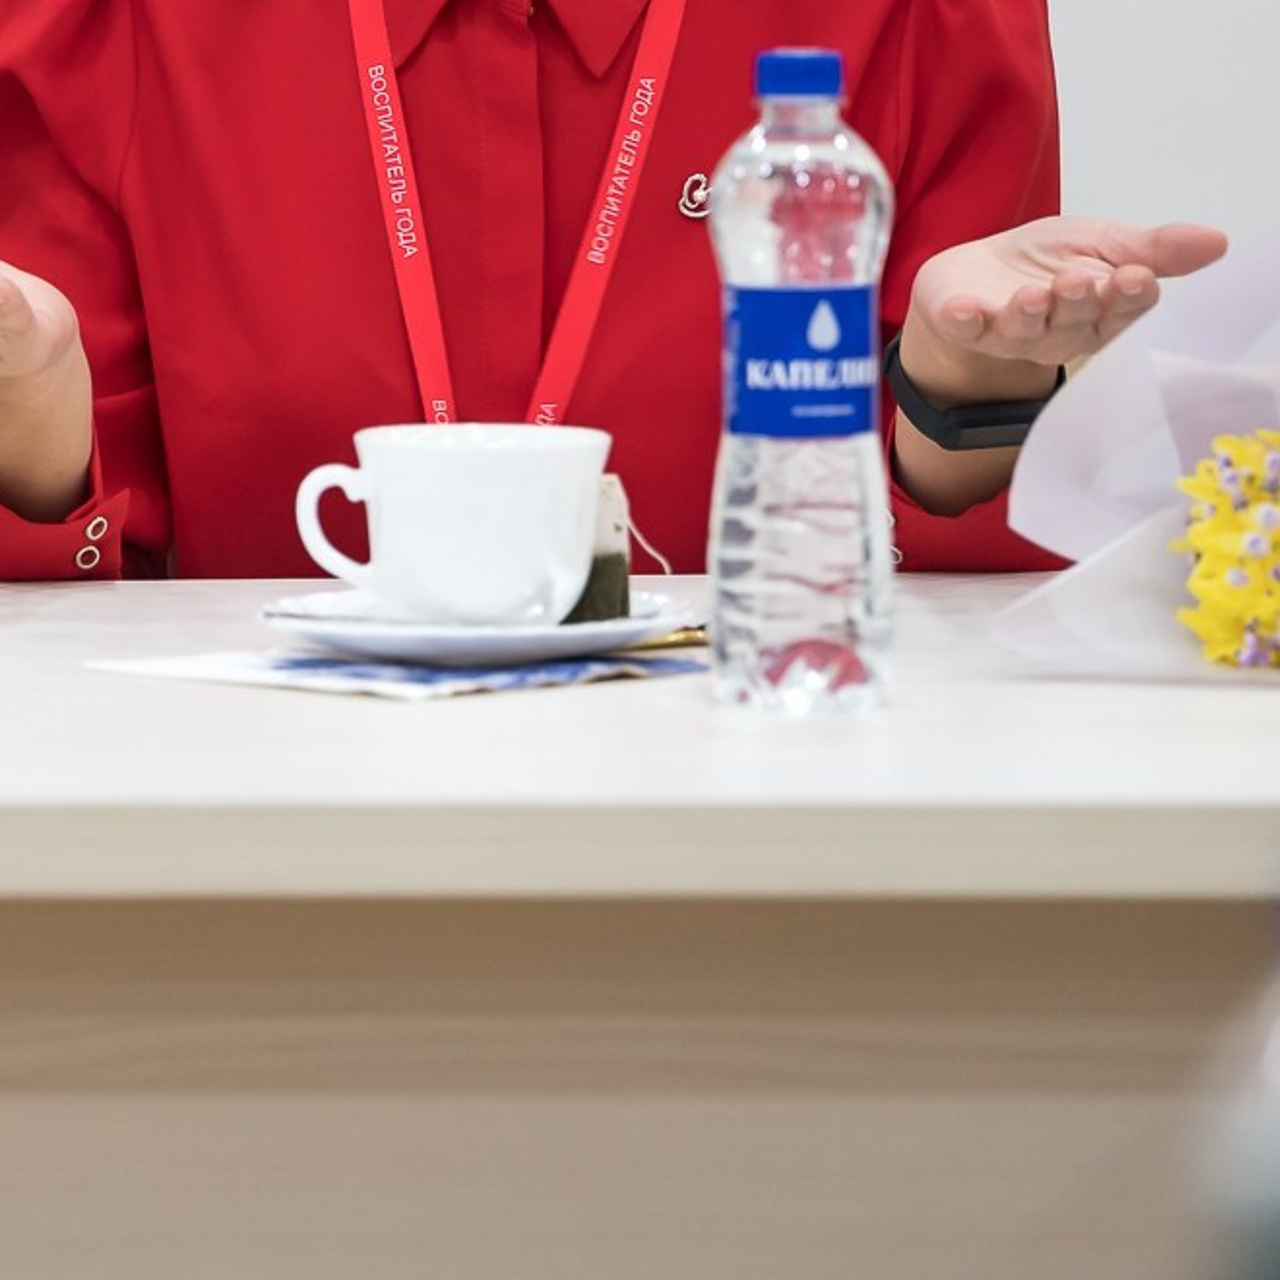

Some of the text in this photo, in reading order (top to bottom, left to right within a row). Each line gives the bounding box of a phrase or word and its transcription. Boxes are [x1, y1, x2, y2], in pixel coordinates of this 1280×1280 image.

[368, 64, 419, 259] ВОСПИТАТЕЛЬ ГОДА
[586, 76, 657, 265] ВОСПИТАТЕЛЬ ГОДА
[746, 355, 880, 392] КАПЕЛИ
